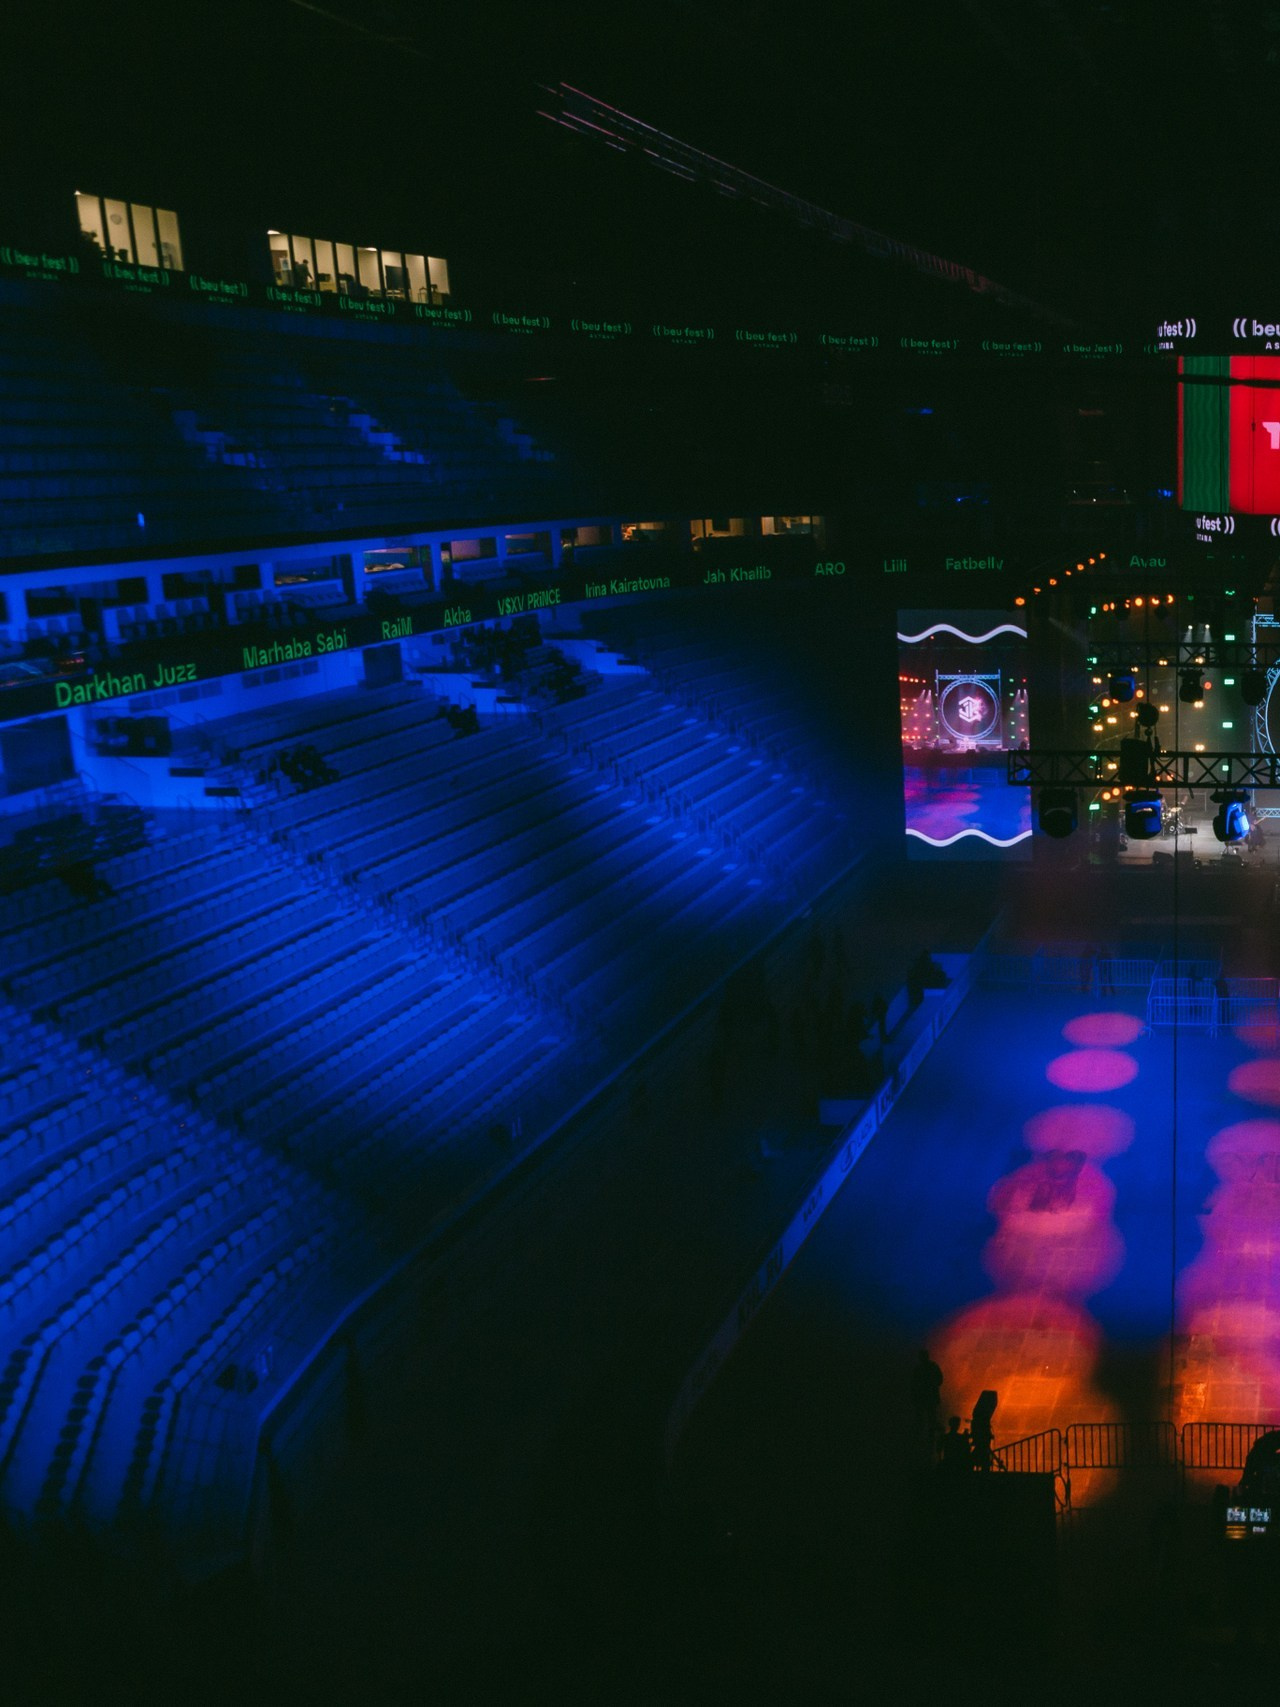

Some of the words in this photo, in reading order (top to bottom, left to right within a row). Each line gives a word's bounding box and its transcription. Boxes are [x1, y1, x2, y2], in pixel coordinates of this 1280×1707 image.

[1164, 320, 1183, 337] fest
[1202, 515, 1221, 532] fest
[703, 569, 725, 585] Jah
[730, 566, 772, 582] Khalib
[815, 562, 845, 576] ARO
[585, 582, 607, 599] Irina
[610, 575, 670, 595] Kairatovna
[381, 616, 412, 640] RaiM
[444, 606, 471, 628] Akha
[243, 638, 312, 669] Marhaba
[316, 628, 348, 654] Sabi
[55, 670, 146, 708] Darkhan
[152, 662, 197, 688] Juzz
